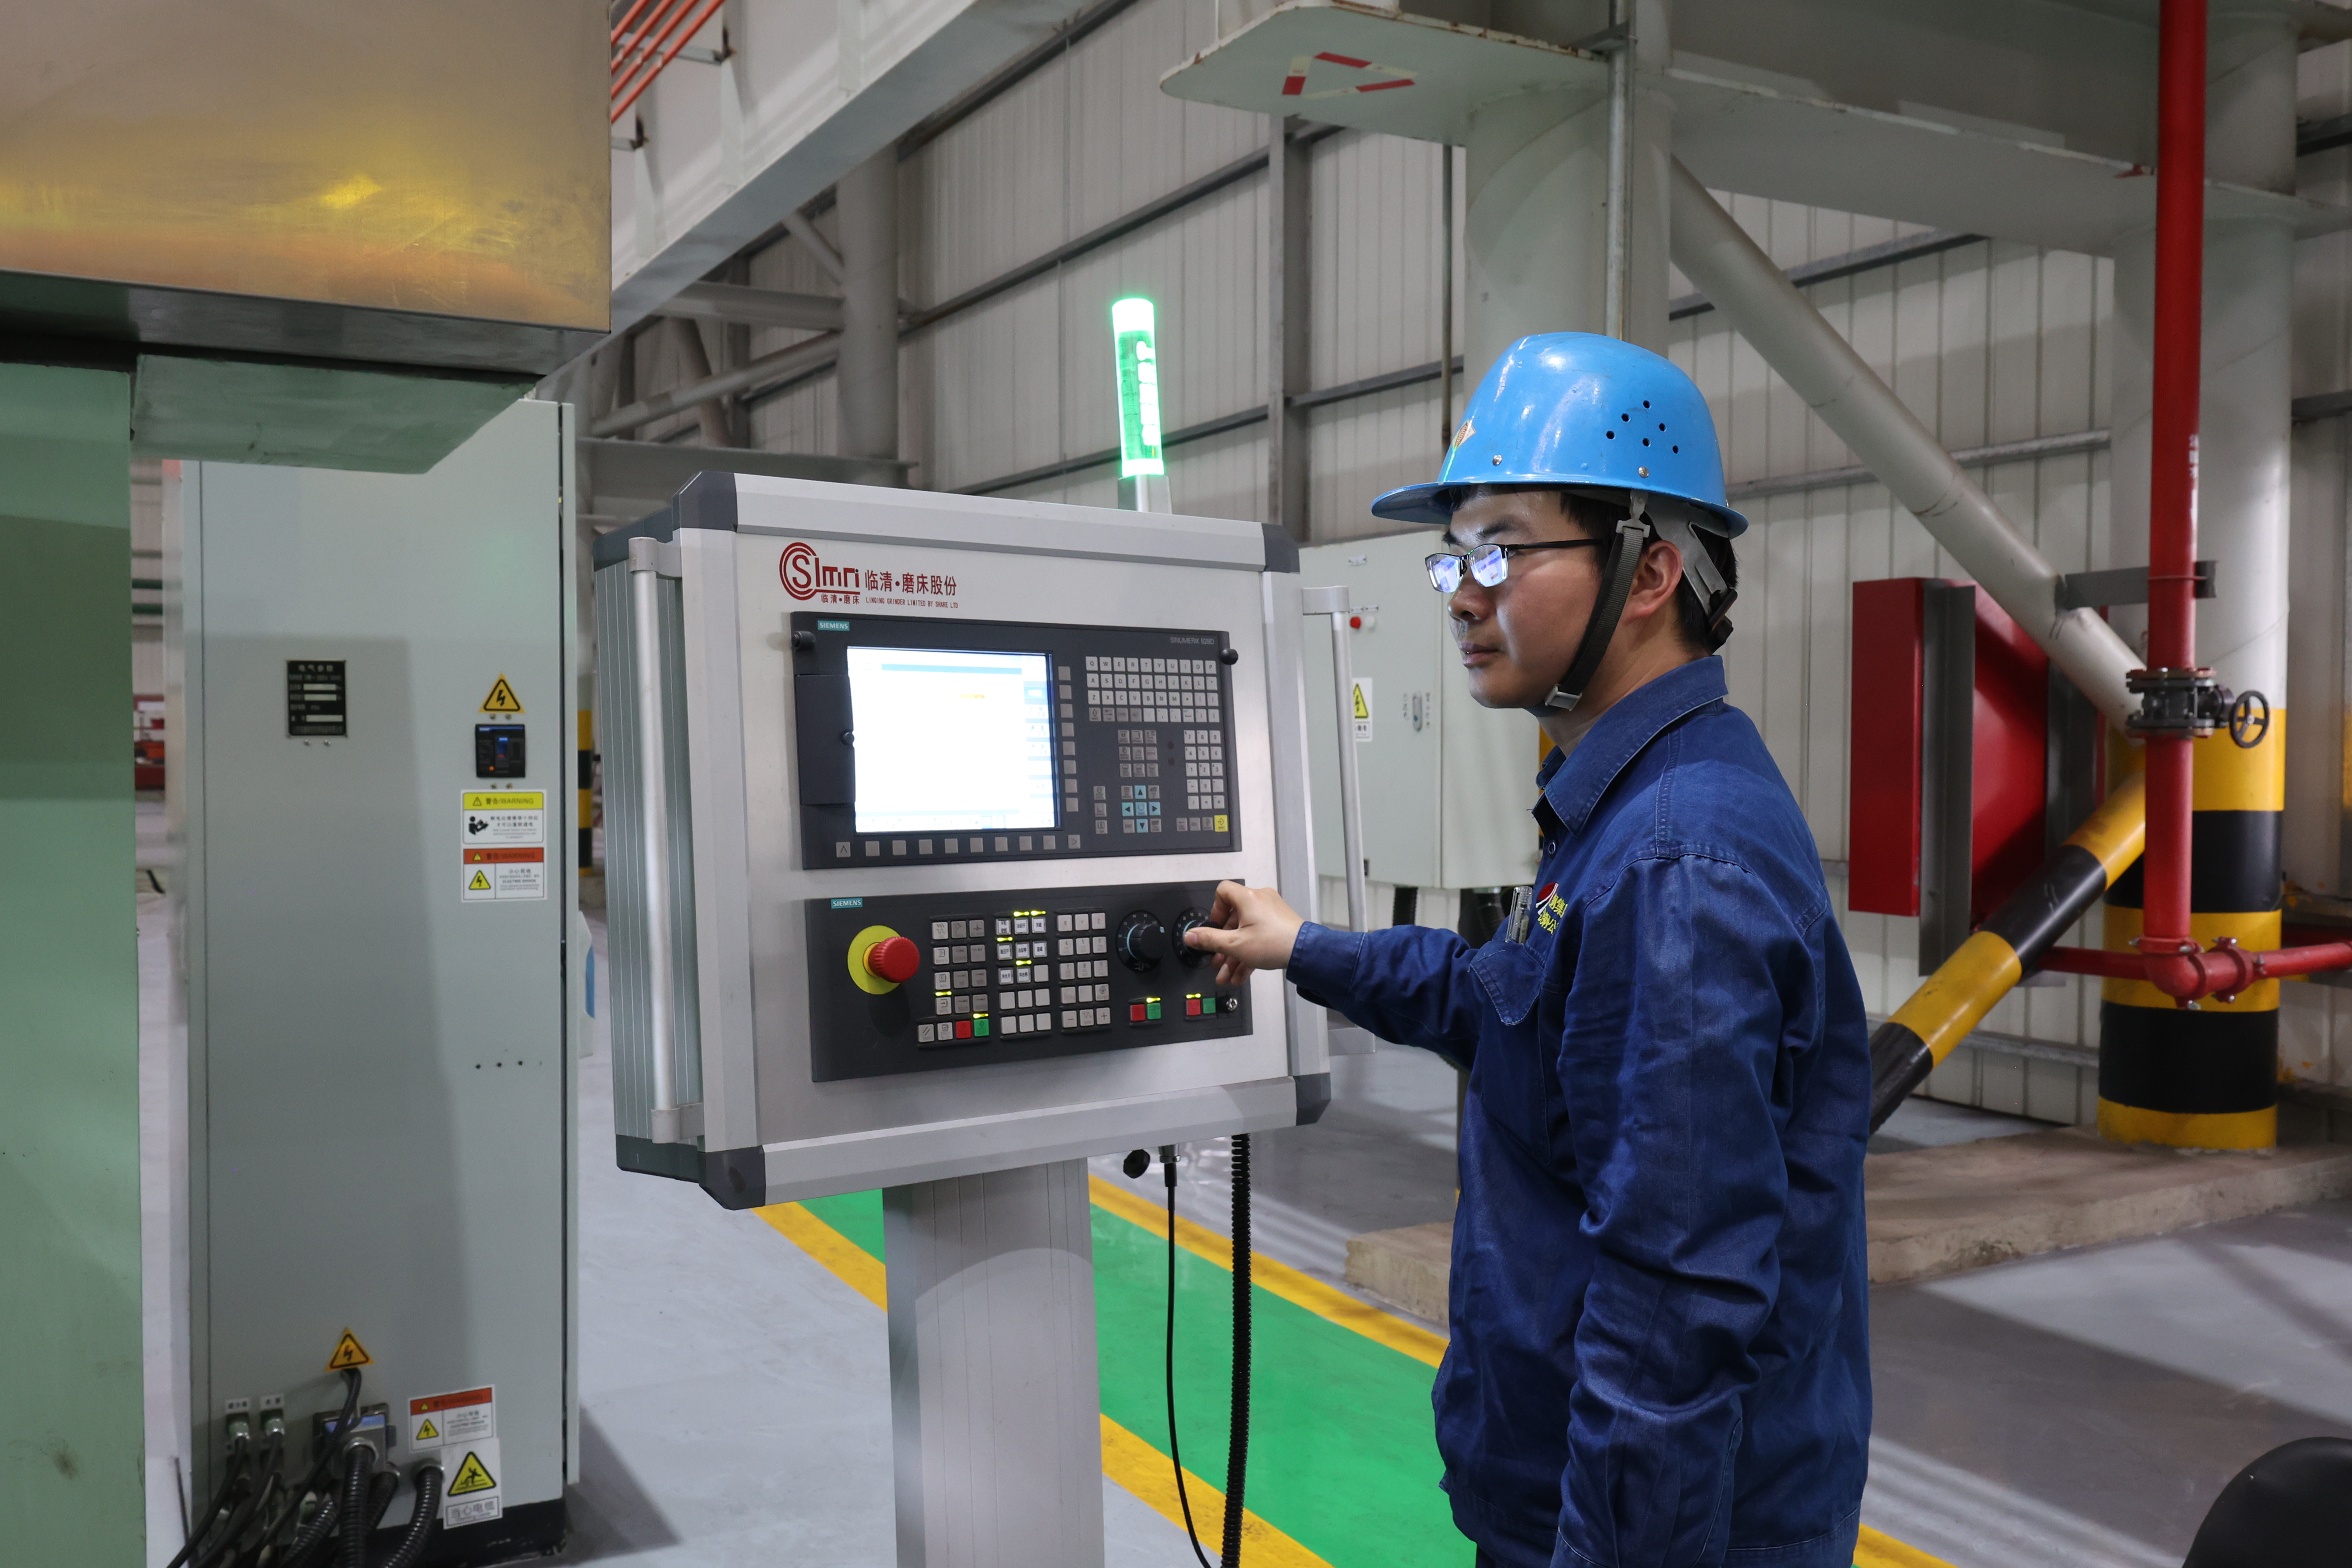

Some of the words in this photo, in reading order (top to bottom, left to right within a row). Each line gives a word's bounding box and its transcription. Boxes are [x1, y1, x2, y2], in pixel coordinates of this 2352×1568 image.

[864, 570, 957, 596] 临清·磨床股份
[821, 593, 860, 604] 临清·磨床
